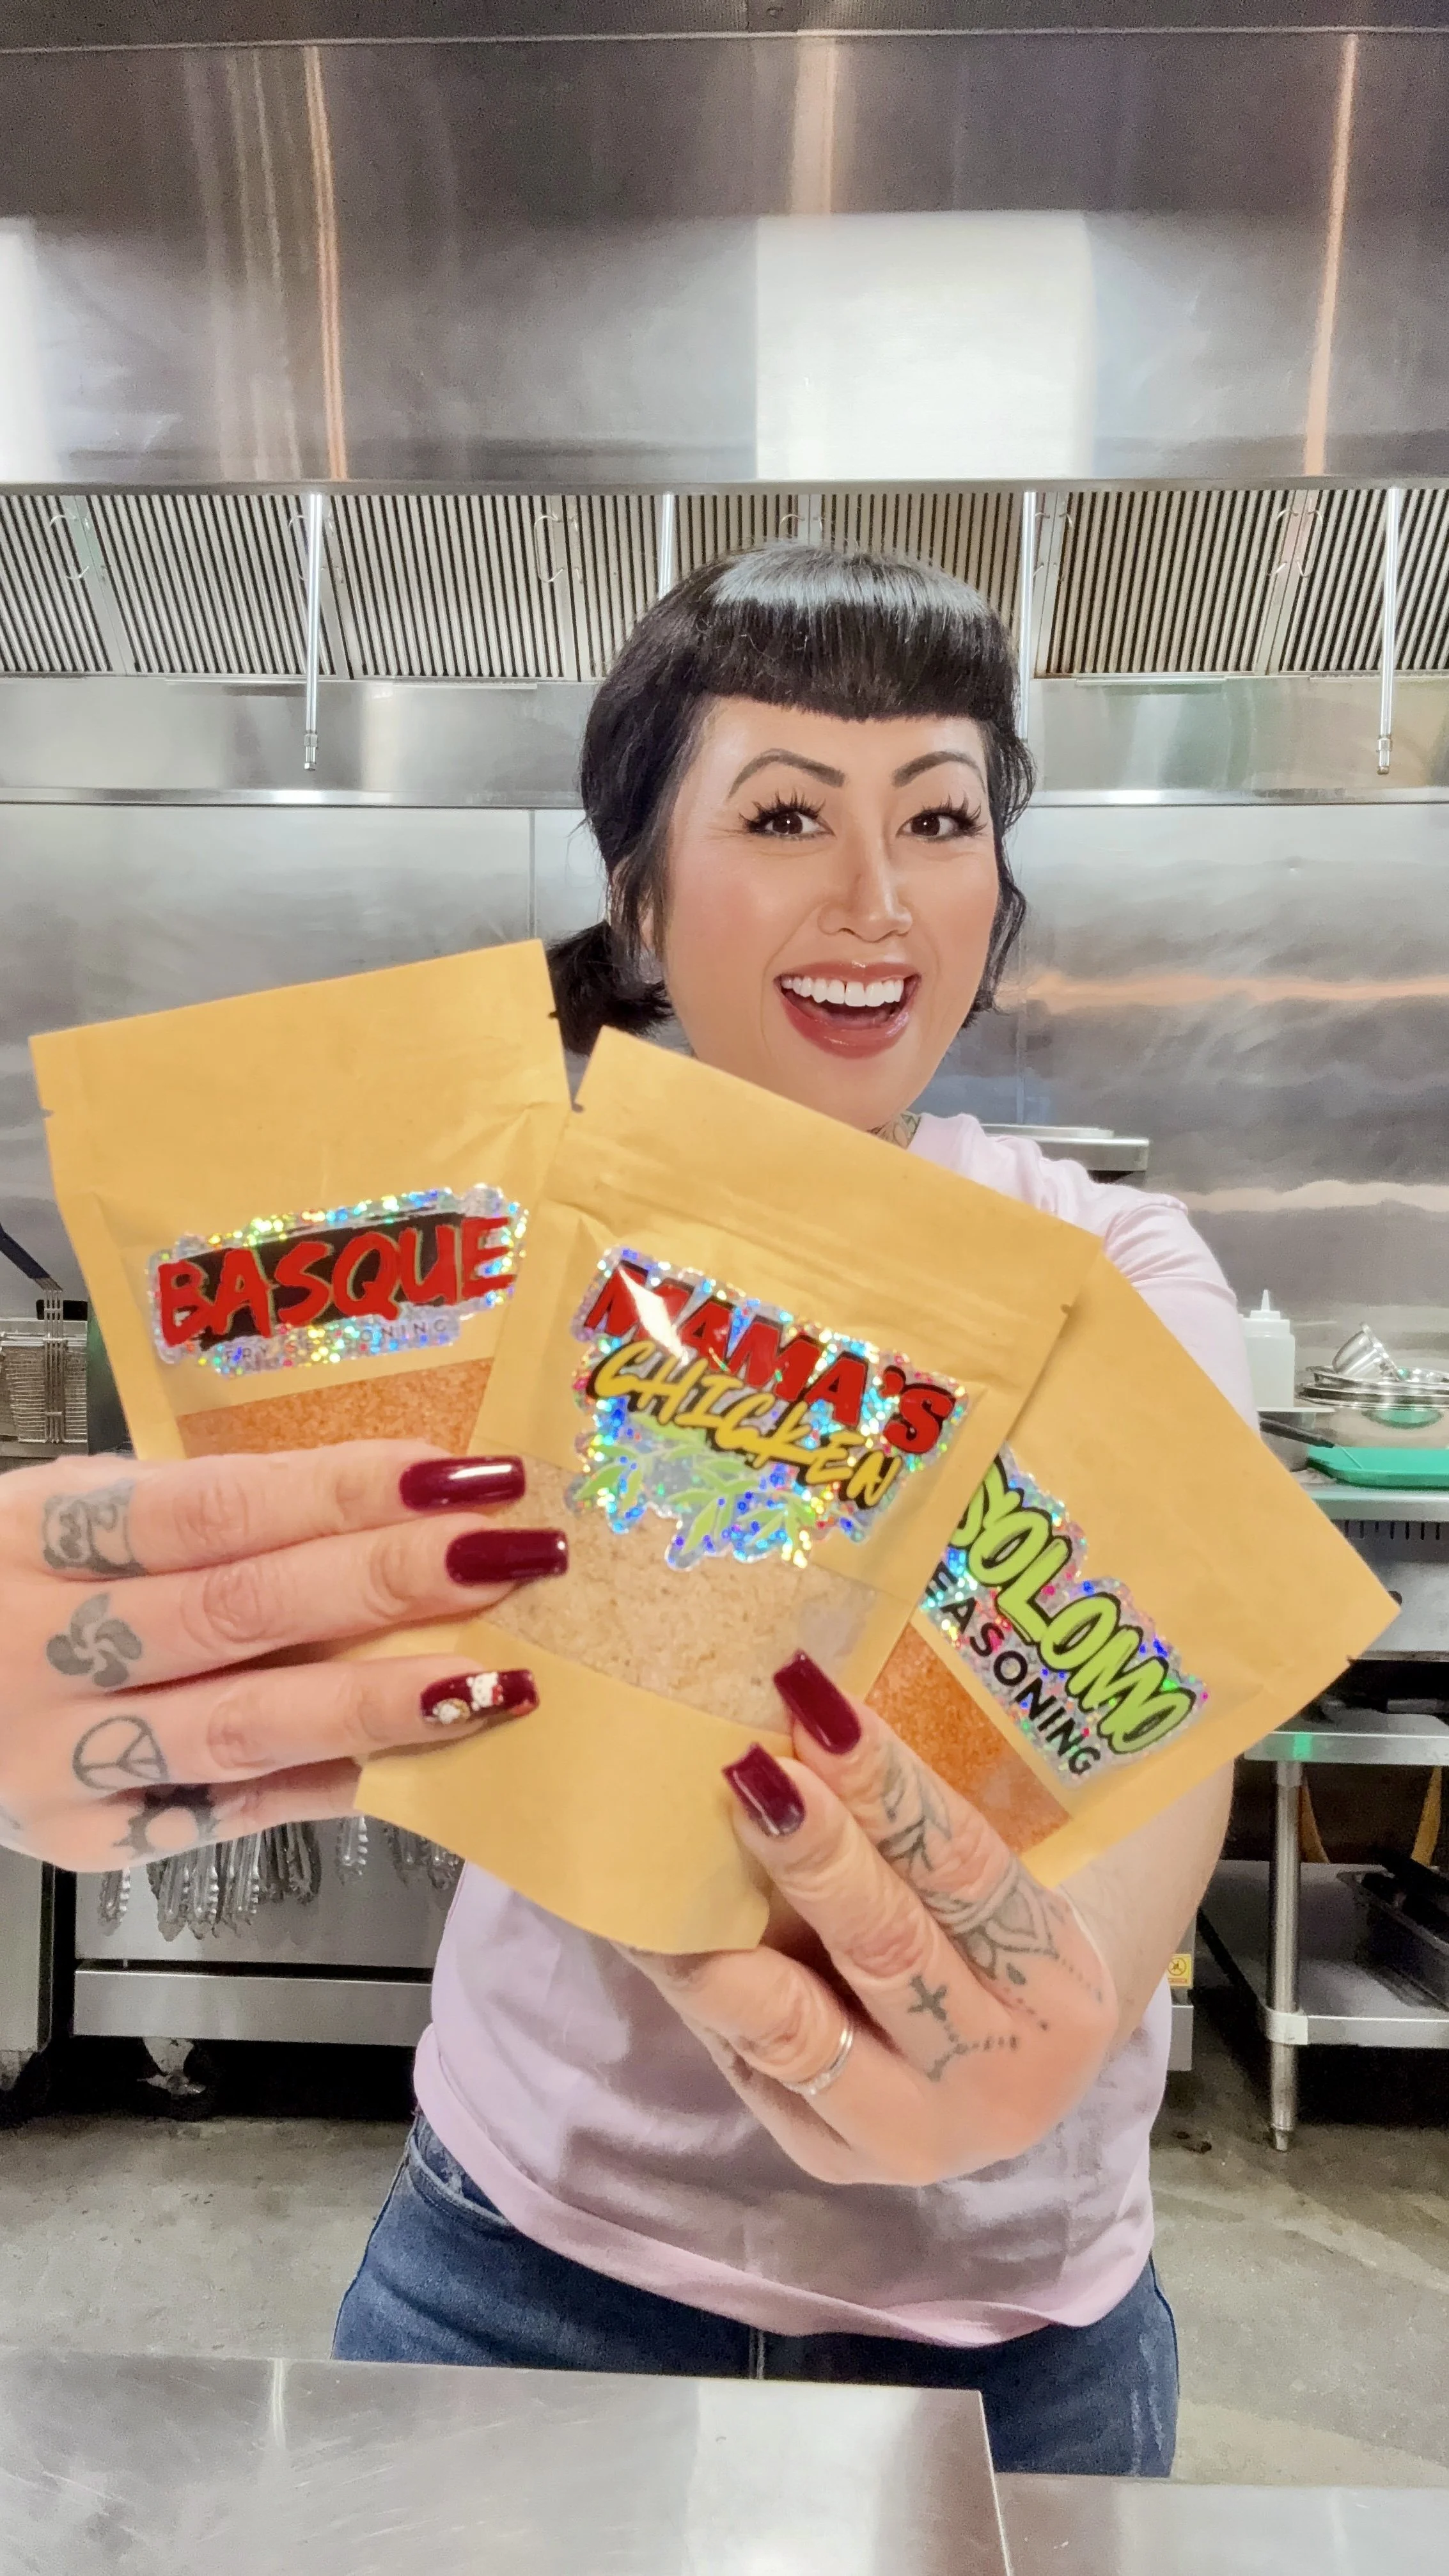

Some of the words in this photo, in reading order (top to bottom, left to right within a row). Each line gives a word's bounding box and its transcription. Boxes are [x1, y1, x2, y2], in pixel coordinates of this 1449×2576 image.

[157, 1216, 516, 1348] BASQUE
[583, 1259, 957, 1454] MAMA'S
[586, 1340, 902, 1509] CHICKEN
